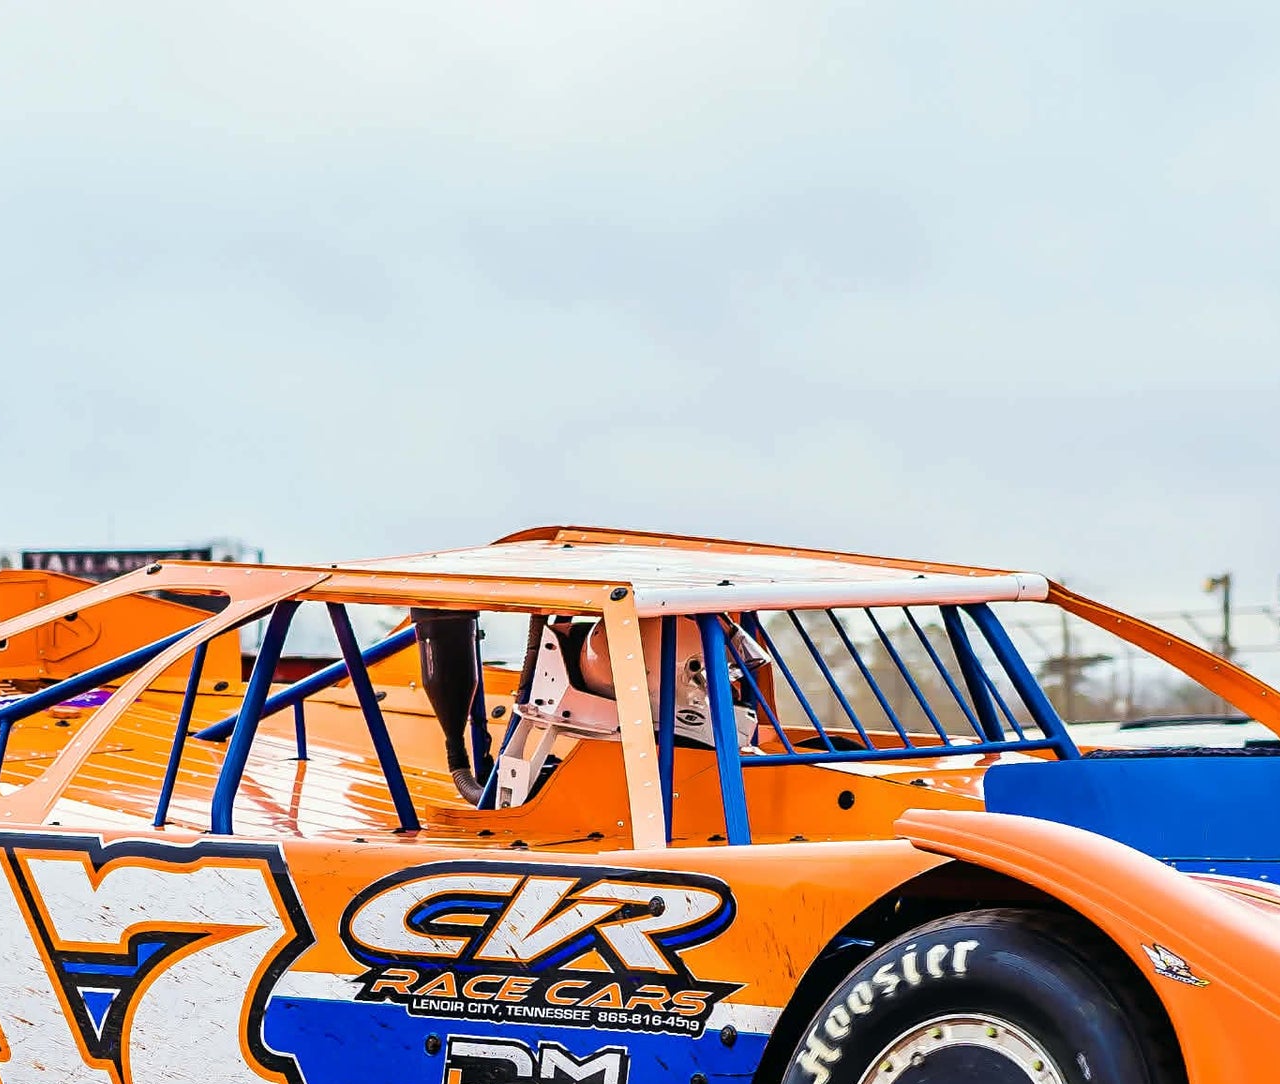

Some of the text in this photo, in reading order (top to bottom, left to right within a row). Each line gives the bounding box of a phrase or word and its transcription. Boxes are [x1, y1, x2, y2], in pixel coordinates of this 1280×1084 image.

[349, 872, 722, 975] CVR
[370, 968, 715, 1016] RACE CARS
[412, 998, 465, 1013] LENOIR
[467, 1003, 503, 1018] CITY,
[505, 1005, 591, 1022] TENNESSEE
